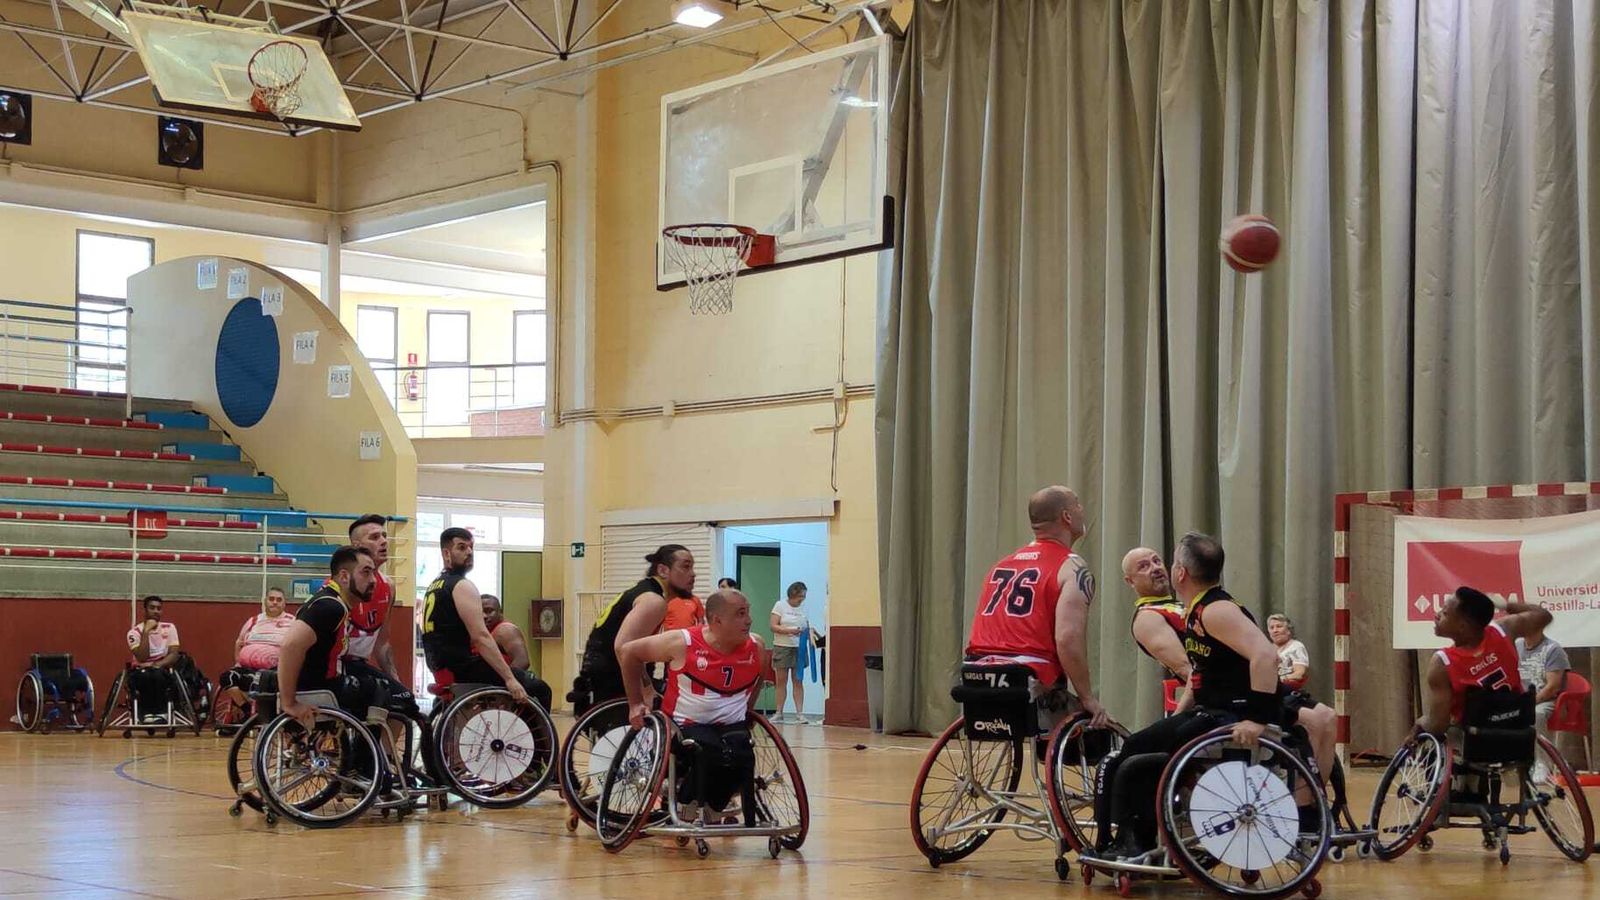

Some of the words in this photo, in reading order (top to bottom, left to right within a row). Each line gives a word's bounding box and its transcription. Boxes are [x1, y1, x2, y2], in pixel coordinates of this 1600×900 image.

[296, 340, 308, 350] FILA
[309, 339, 314, 349] 4
[330, 372, 343, 383] FILA
[361, 437, 374, 448] FILA
[375, 437, 380, 448] 6
[982, 567, 1041, 618] 76
[721, 665, 735, 688] 7
